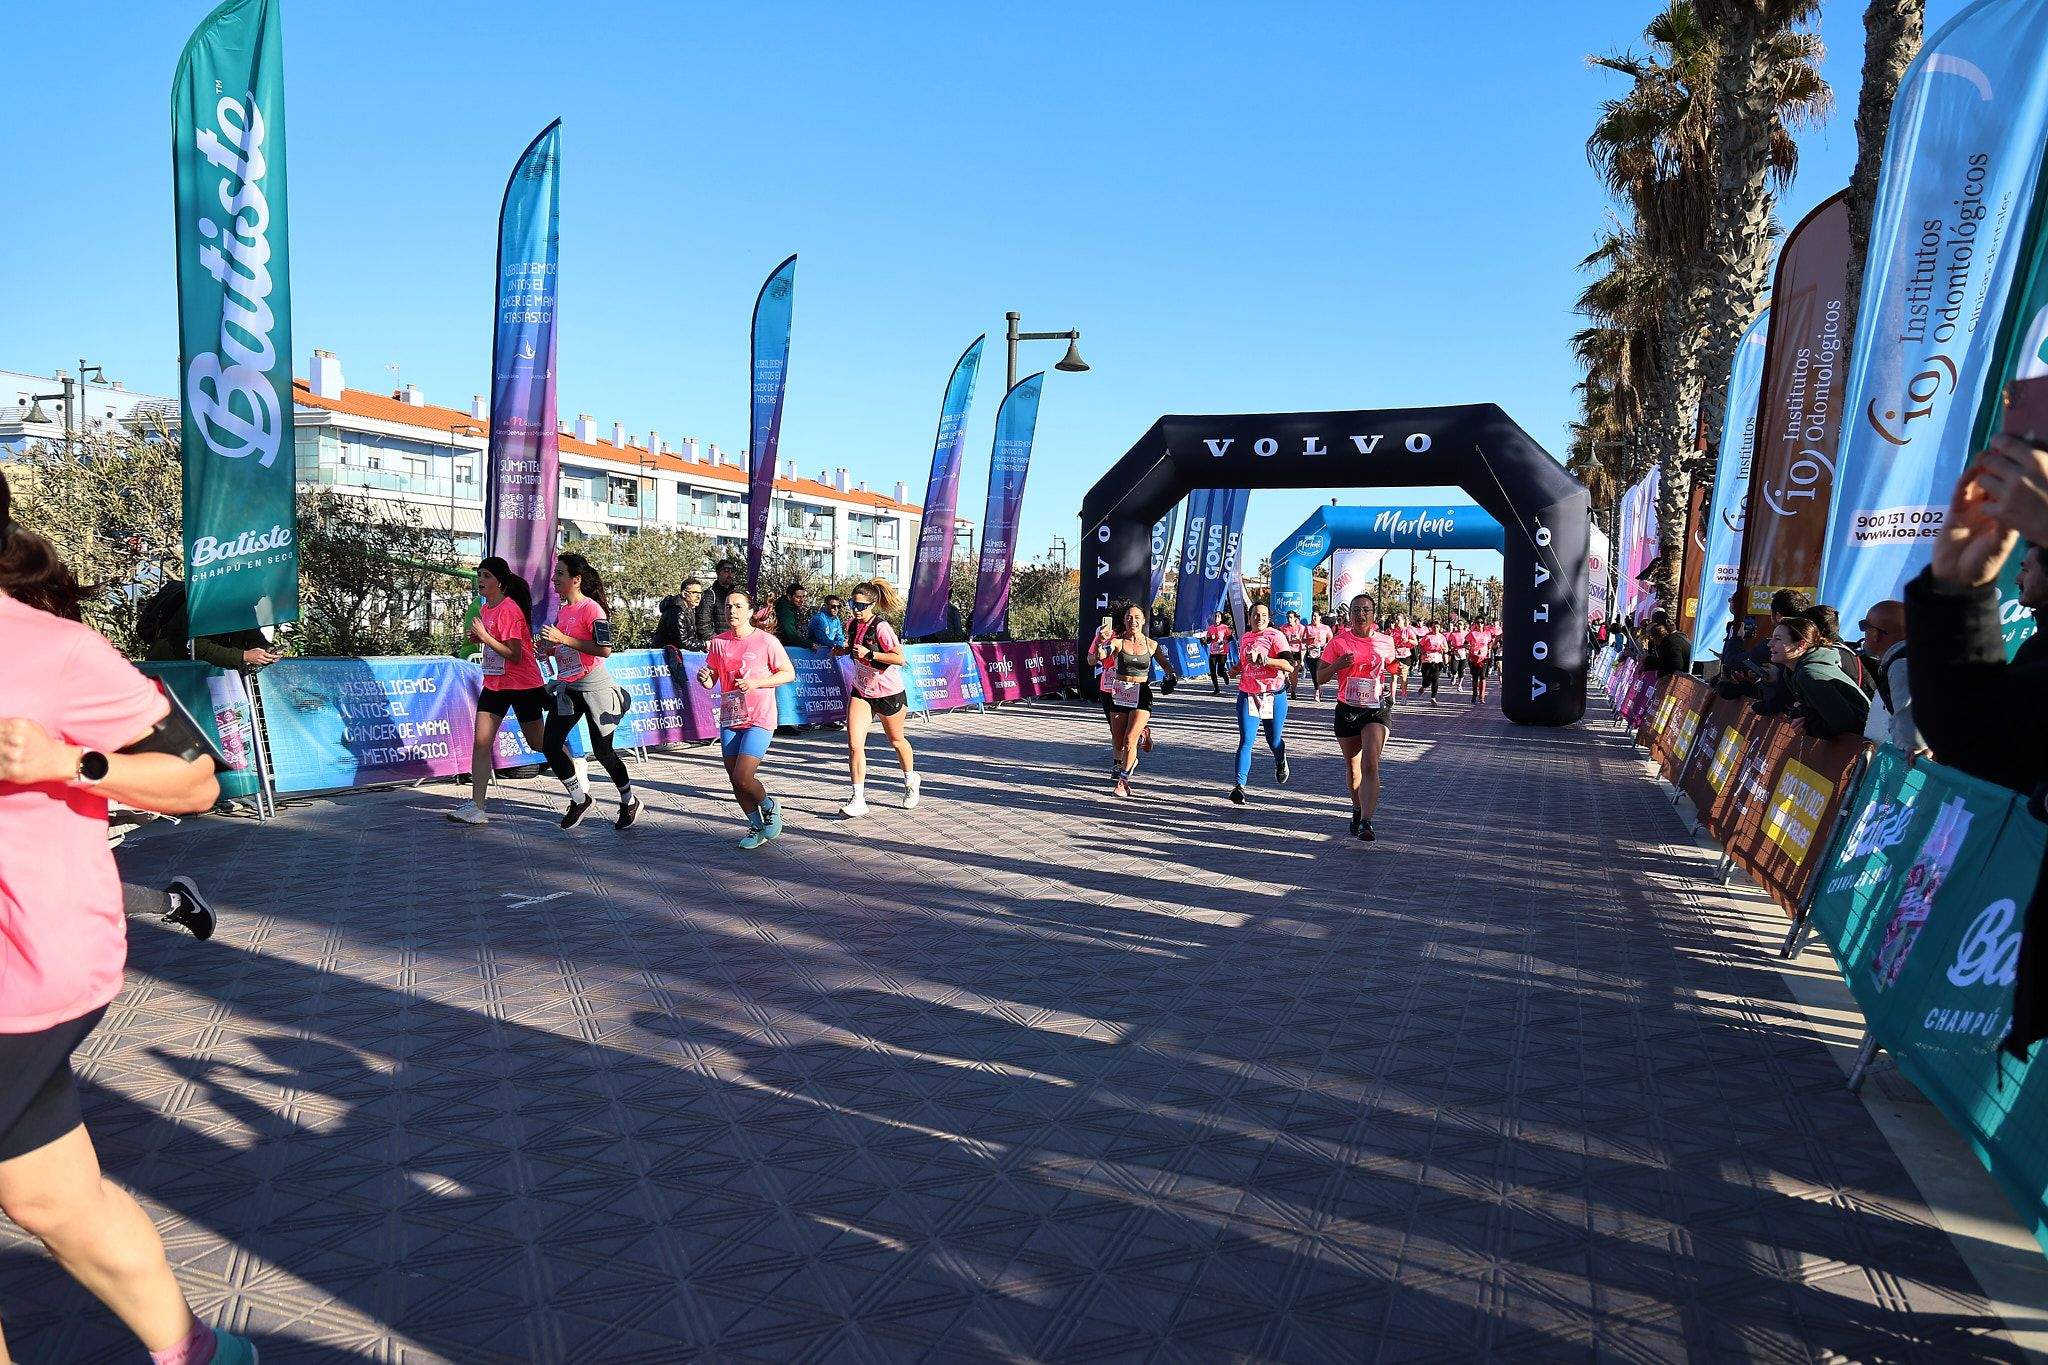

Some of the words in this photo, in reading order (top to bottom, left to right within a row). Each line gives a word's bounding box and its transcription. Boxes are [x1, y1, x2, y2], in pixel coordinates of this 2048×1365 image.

[1933, 153, 1988, 344] Odontológicos
[187, 90, 282, 469] Batiste
[1899, 219, 1943, 344] Institutos
[1805, 300, 1841, 442] Odontológicos
[1783, 348, 1811, 442] Institutos
[1203, 433, 1432, 458] VOLVO
[1737, 416, 1756, 480] Institutos
[1373, 511, 1455, 544] Marlene
[1855, 525, 1941, 541] www.ioa.es
[1857, 515, 1885, 528] 900
[1888, 512, 1905, 525] 131
[1910, 511, 1944, 524] 002
[191, 525, 293, 567] Batiste
[1186, 516, 1206, 575] GOYA
[1204, 524, 1223, 580] GOYA
[191, 561, 241, 582] CHAMPÚ
[247, 559, 262, 569] EN
[267, 551, 293, 565] SECO
[1532, 526, 1551, 700] VOLVO
[988, 654, 1013, 678] renfe
[337, 677, 437, 697] VISIBILICEMOS
[339, 701, 389, 719] JUNTOS
[390, 701, 410, 717] EL
[344, 720, 397, 743] CÁNCER
[399, 722, 415, 739] DE
[416, 719, 450, 737] MAMA
[362, 739, 449, 765] METASTÁSICO
[1924, 1006, 2001, 1037] CHAMPÚ
